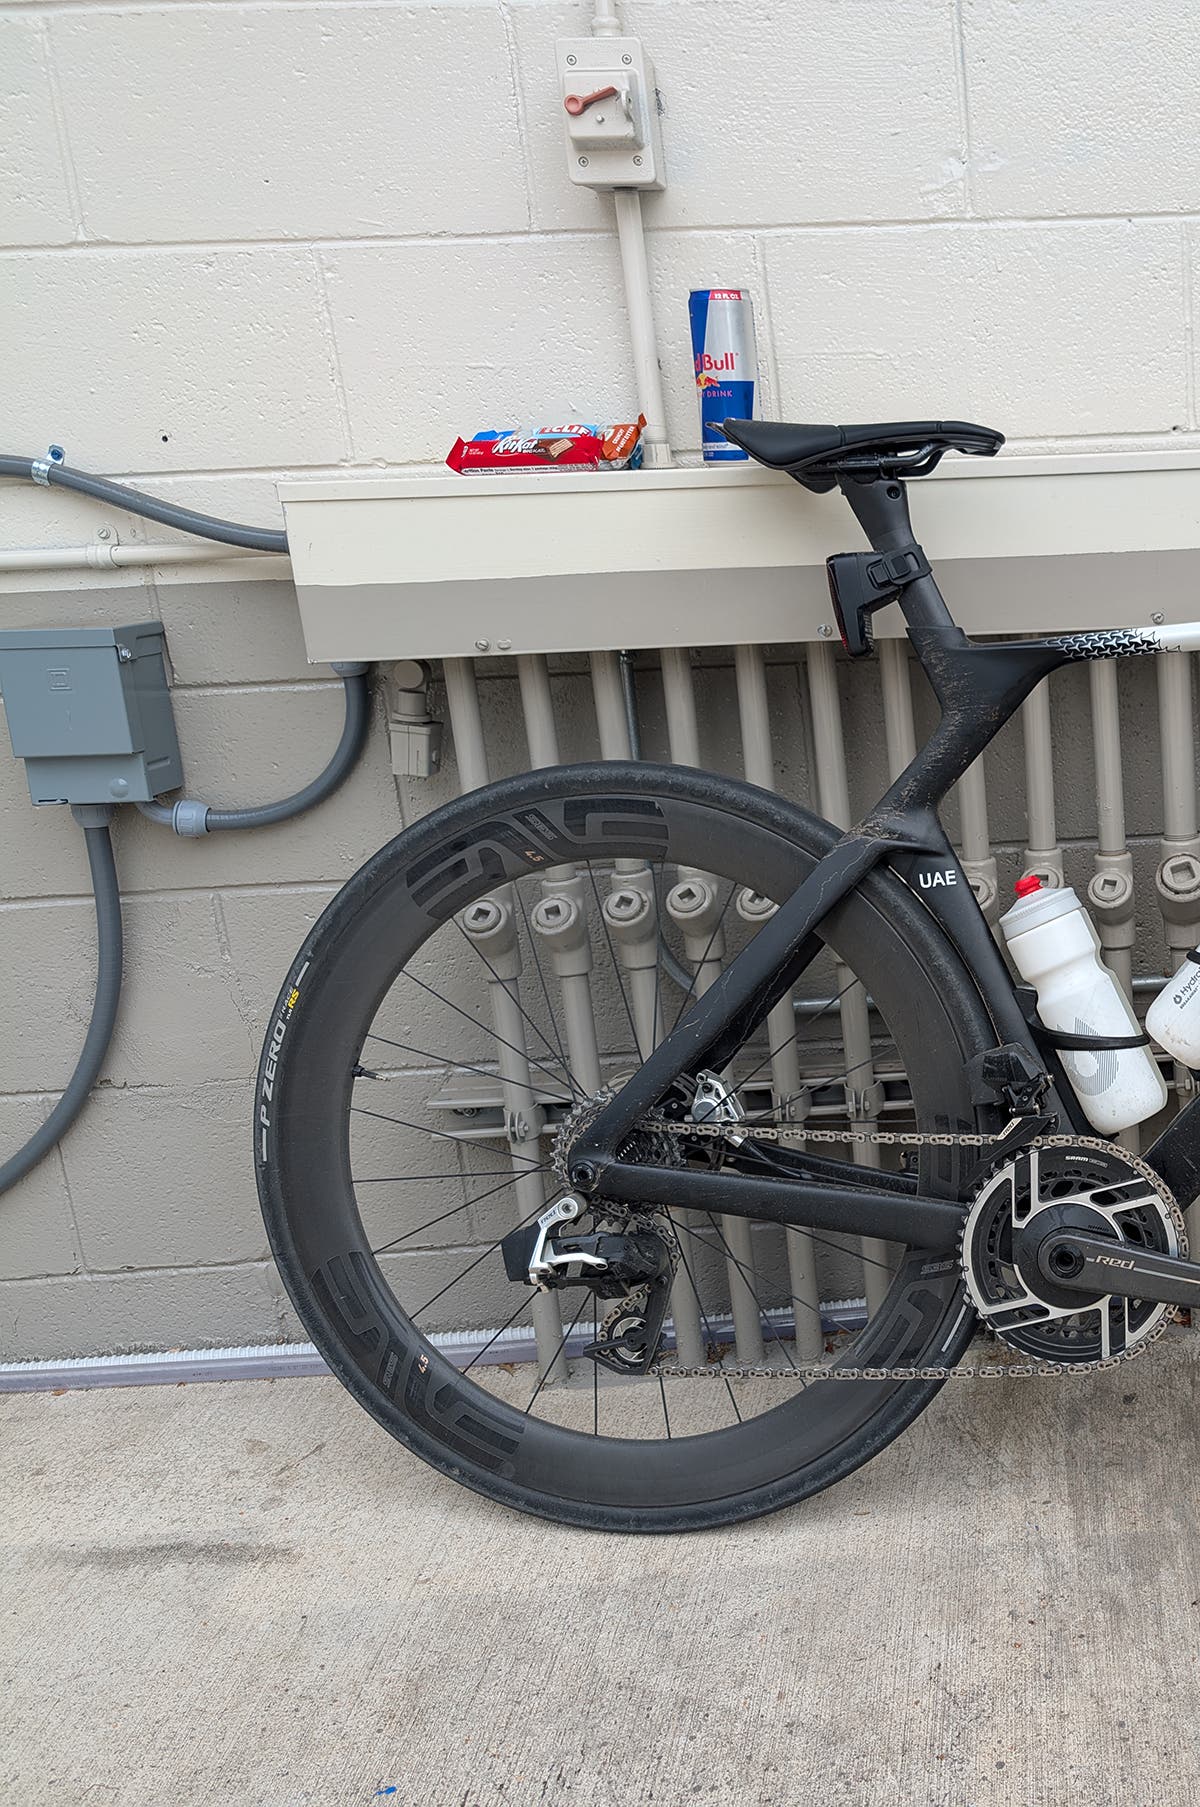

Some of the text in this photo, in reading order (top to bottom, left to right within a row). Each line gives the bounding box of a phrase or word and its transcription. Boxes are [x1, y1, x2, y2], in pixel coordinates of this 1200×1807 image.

[702, 352, 734, 371] Bull
[551, 425, 591, 436] CLIF
[524, 849, 545, 863] 4.5
[919, 870, 957, 889] UAE
[288, 988, 300, 1010] RS
[261, 1019, 288, 1127] P ZERO
[418, 1354, 430, 1375] 4.5
